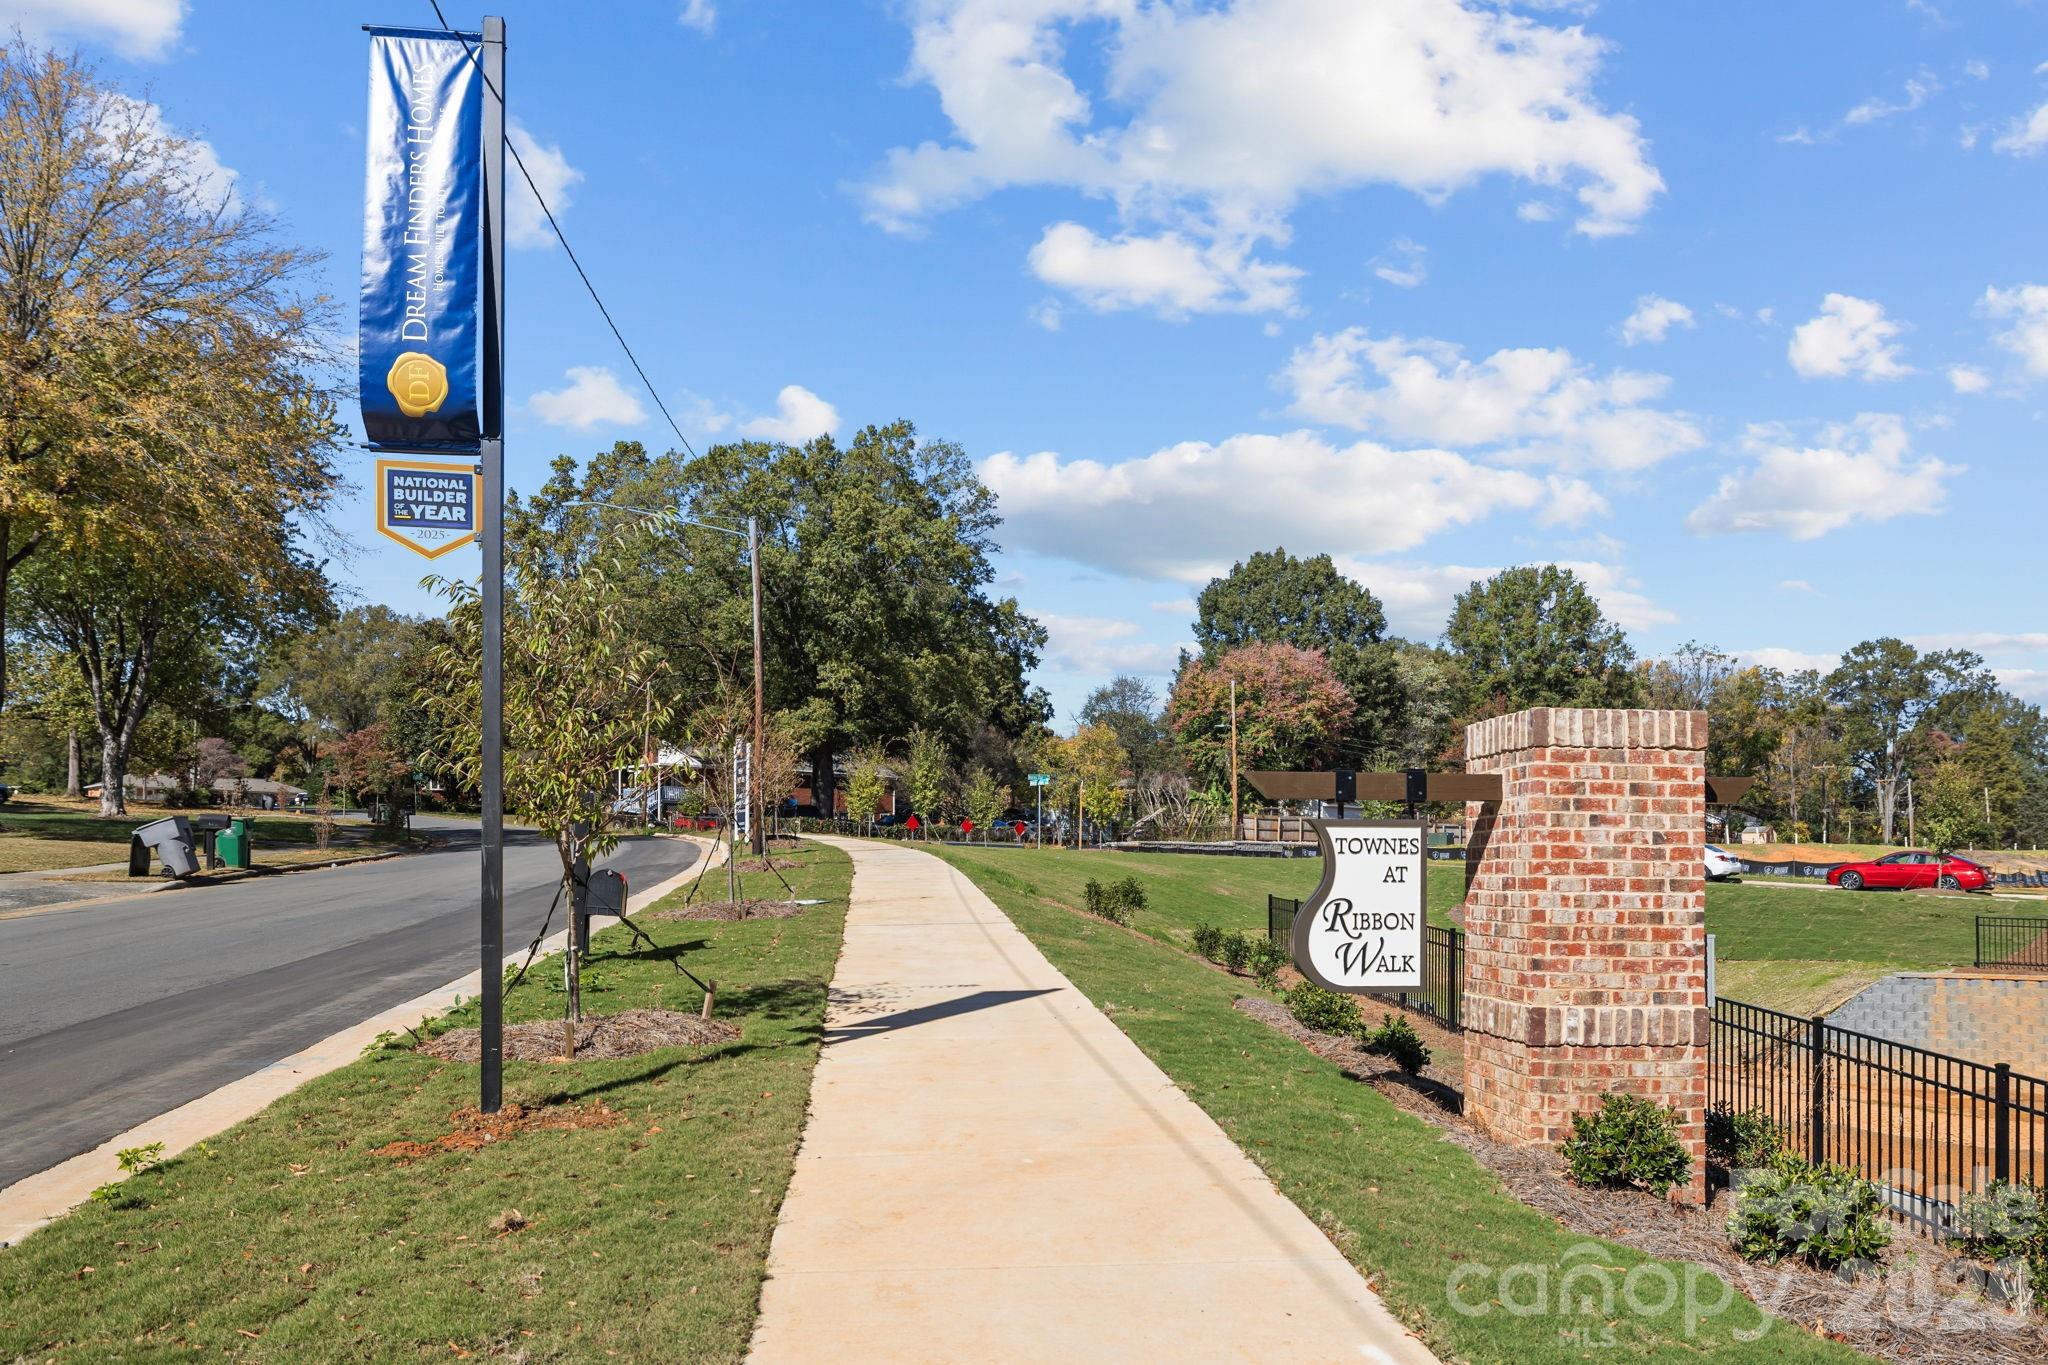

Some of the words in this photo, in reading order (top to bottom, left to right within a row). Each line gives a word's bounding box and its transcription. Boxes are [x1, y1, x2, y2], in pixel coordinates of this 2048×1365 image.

[406, 63, 434, 145] HOMES
[403, 151, 432, 246] FINDERS
[401, 251, 428, 343] DREAM
[408, 363, 430, 401] DF
[393, 476, 467, 490] NATIONAL
[393, 488, 467, 504] BUILDER
[410, 504, 466, 522] YEAR
[417, 530, 445, 540] 2025
[1335, 838, 1419, 855] TOWNES
[1382, 866, 1408, 883] AT
[1323, 897, 1416, 939] RIBBON
[1334, 937, 1416, 977] WALK
